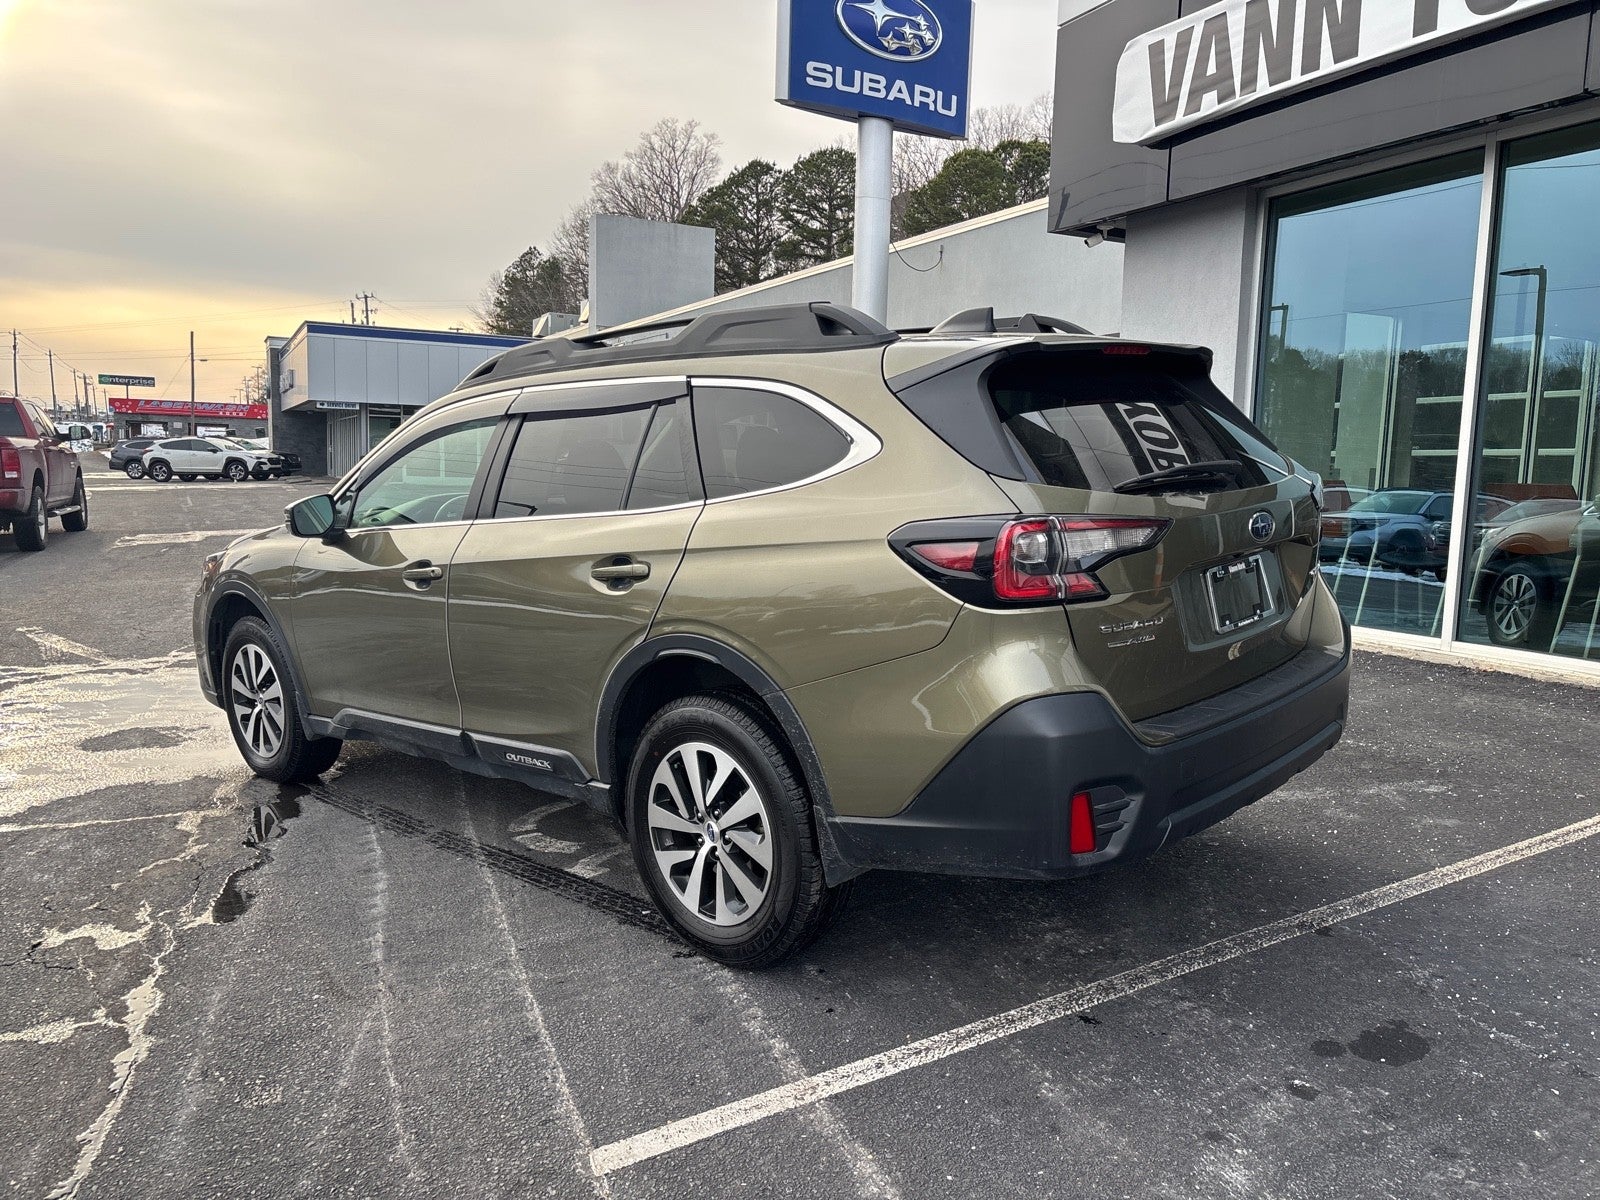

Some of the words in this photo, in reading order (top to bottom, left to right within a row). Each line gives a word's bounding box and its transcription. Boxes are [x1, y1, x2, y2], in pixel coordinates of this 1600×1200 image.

[1148, 0, 1363, 128] VANN
[805, 61, 958, 118] SUBARU
[101, 376, 155, 385] enterprise
[138, 400, 250, 412] LASERWASH
[1099, 616, 1164, 634] SUBARU
[505, 752, 552, 769] OUTBACK
